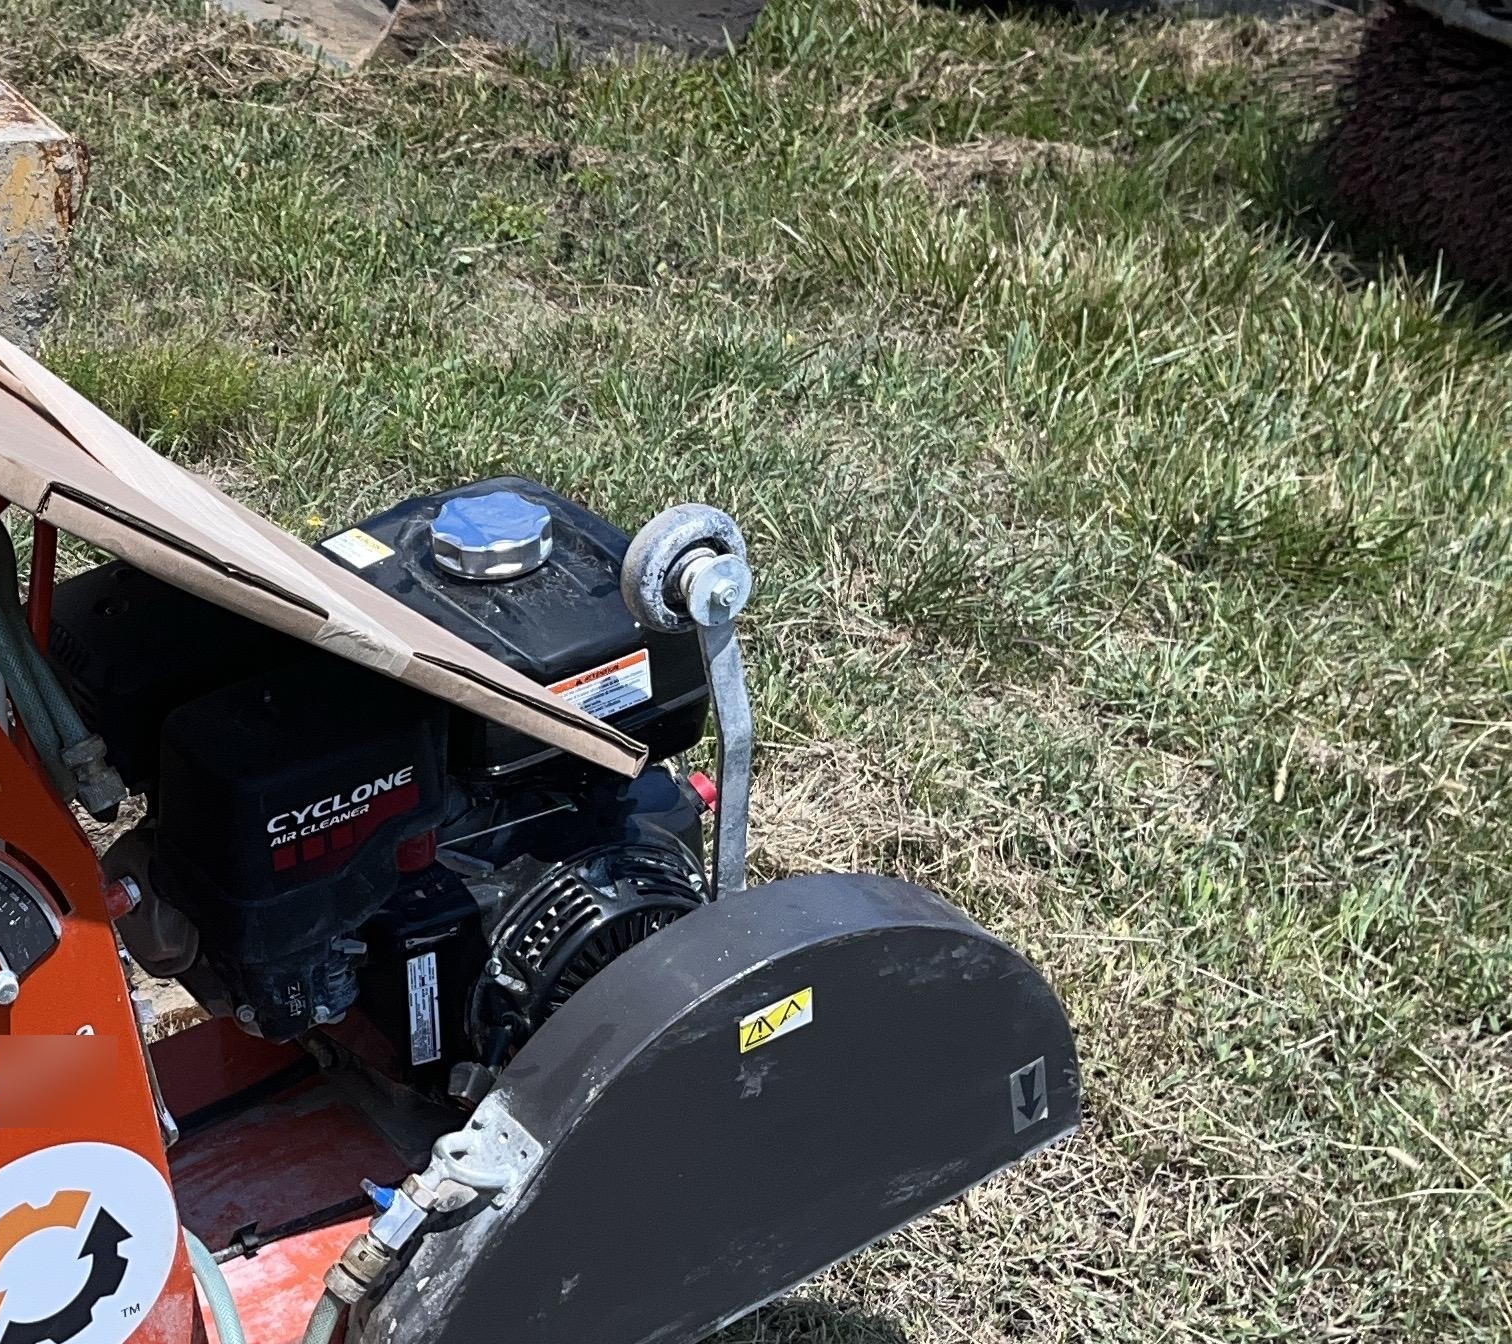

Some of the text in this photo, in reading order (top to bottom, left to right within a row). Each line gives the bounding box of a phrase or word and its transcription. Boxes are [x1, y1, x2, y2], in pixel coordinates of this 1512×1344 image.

[267, 765, 414, 834] CYCLONE
[270, 803, 370, 848] AIR CLEANER
[120, 1303, 141, 1318] TM
